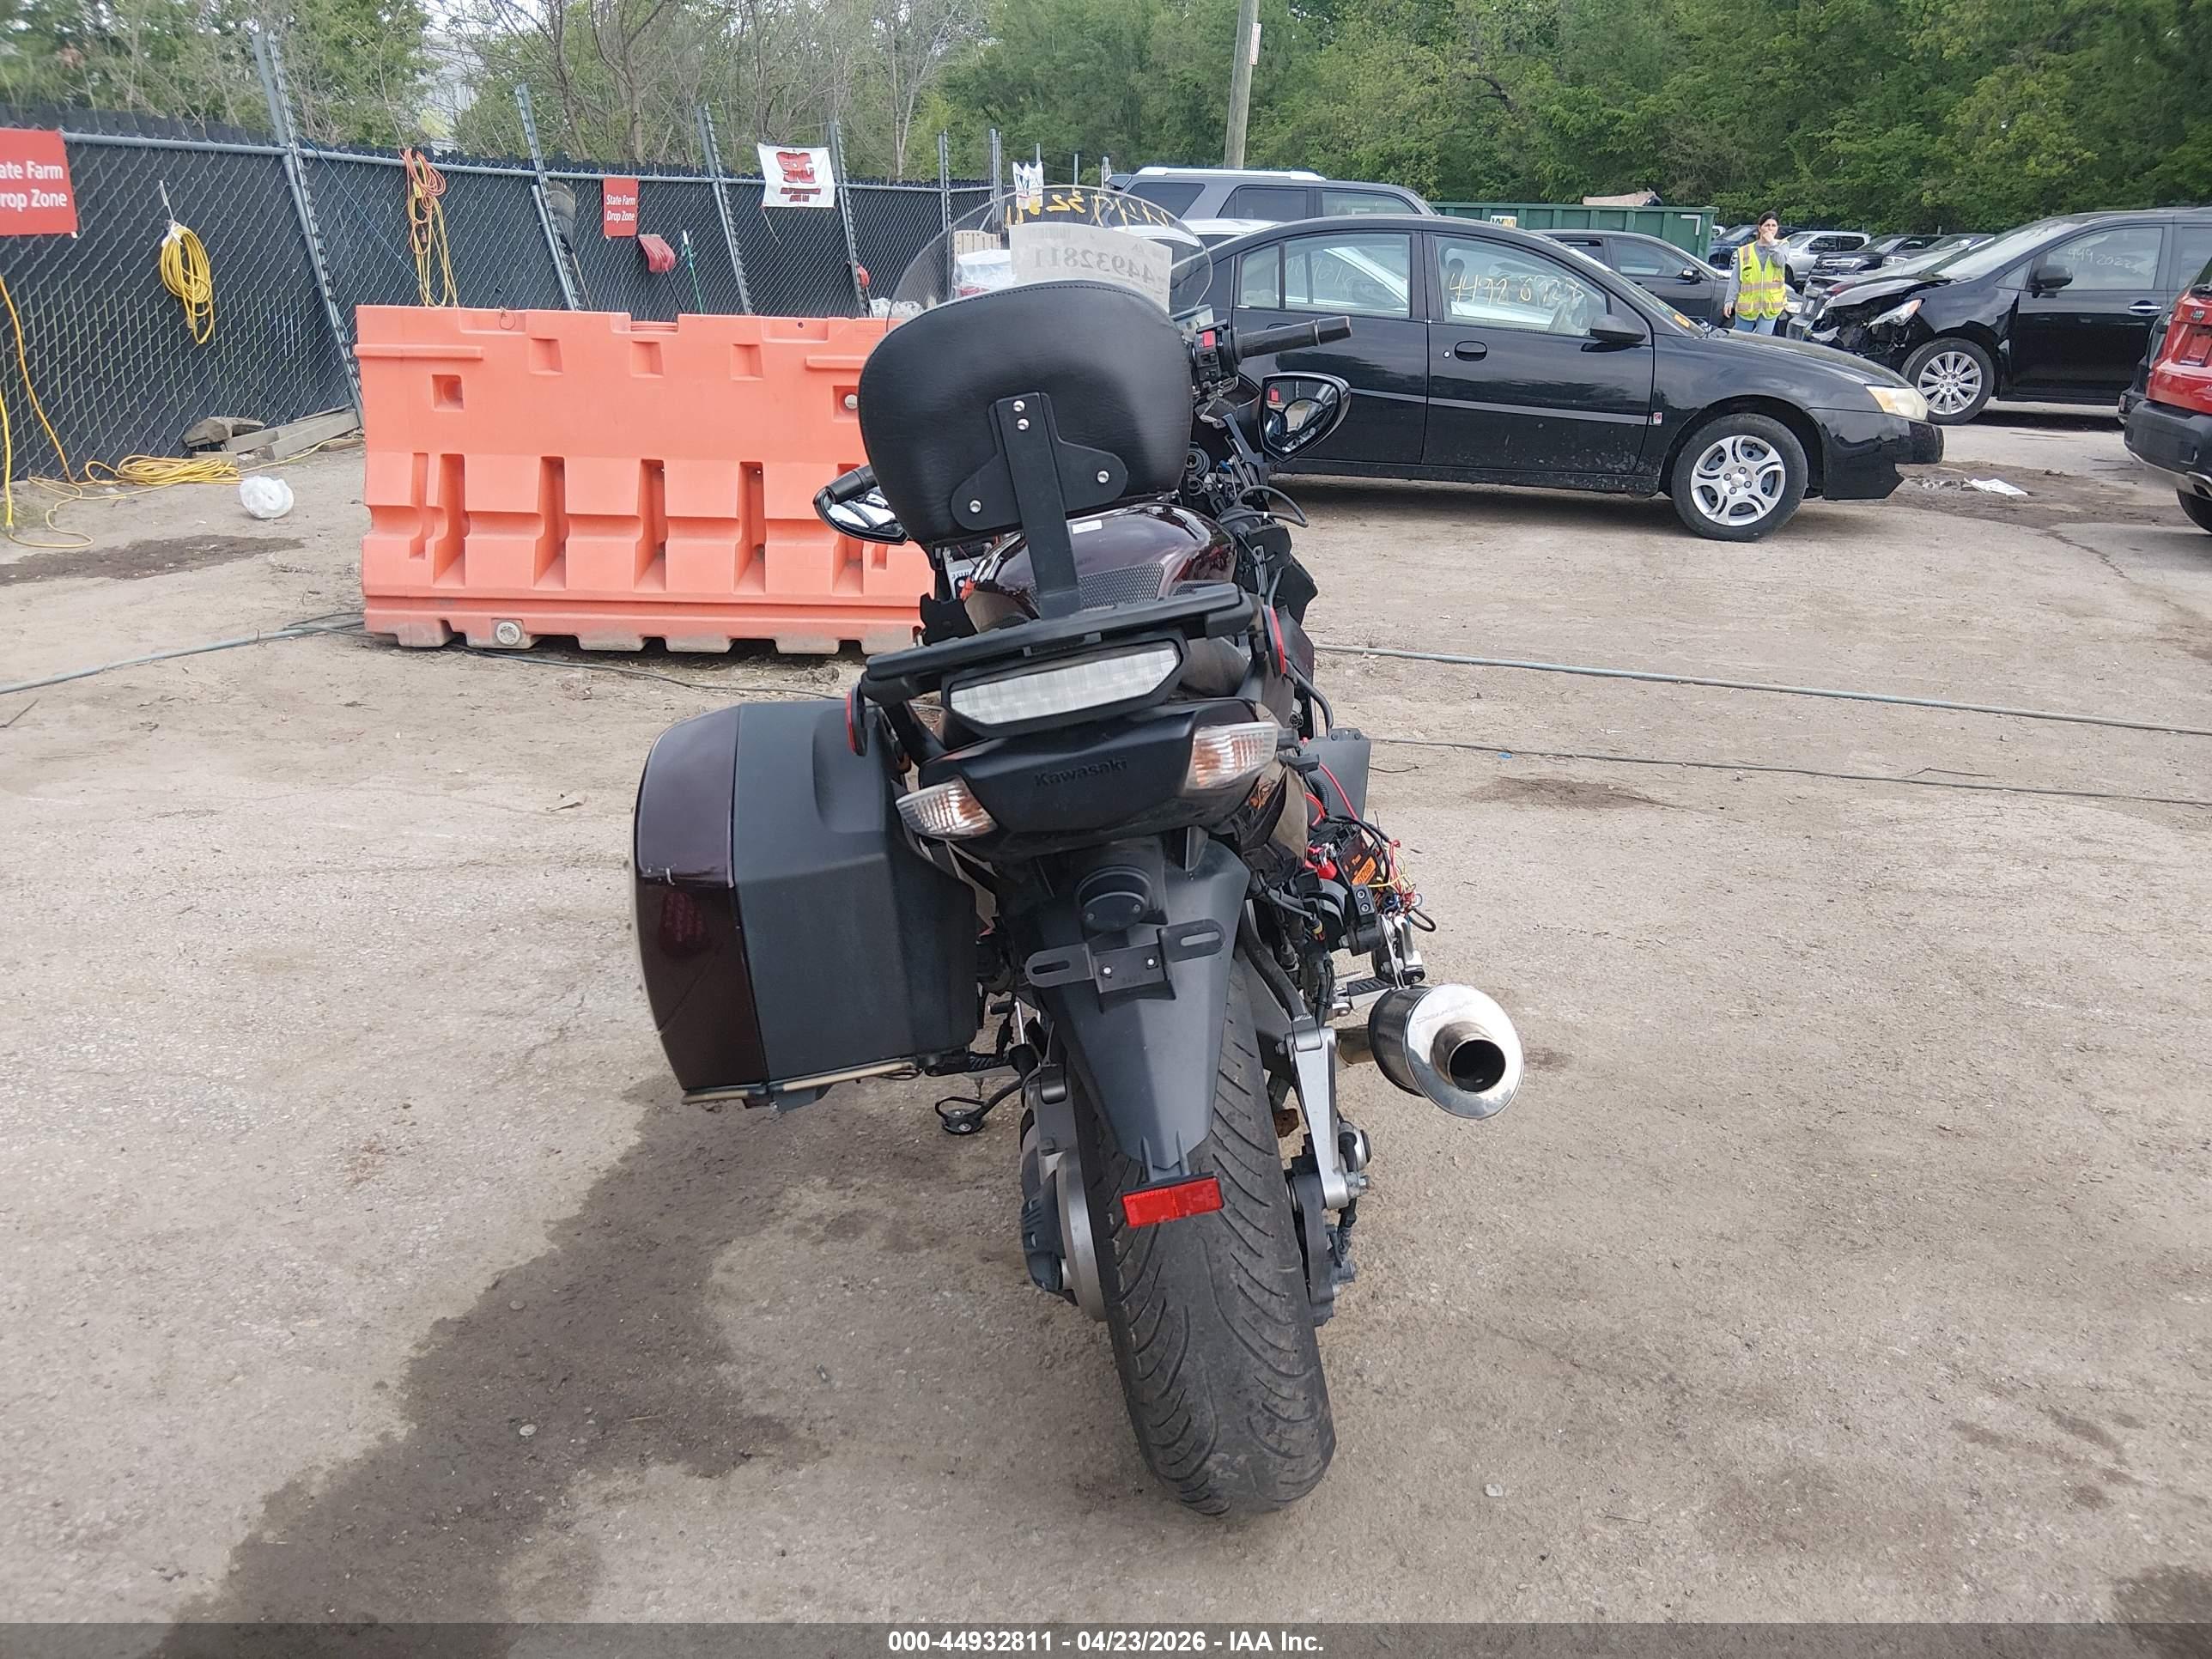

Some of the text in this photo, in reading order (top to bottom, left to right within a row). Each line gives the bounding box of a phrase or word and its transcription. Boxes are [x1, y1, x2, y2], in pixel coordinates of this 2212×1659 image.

[26, 160, 64, 179] Farm
[30, 188, 68, 207] Zone
[606, 193, 636, 206] State Farm
[606, 210, 635, 224] Drop Zone
[1033, 757, 1127, 787] Kawasaki
